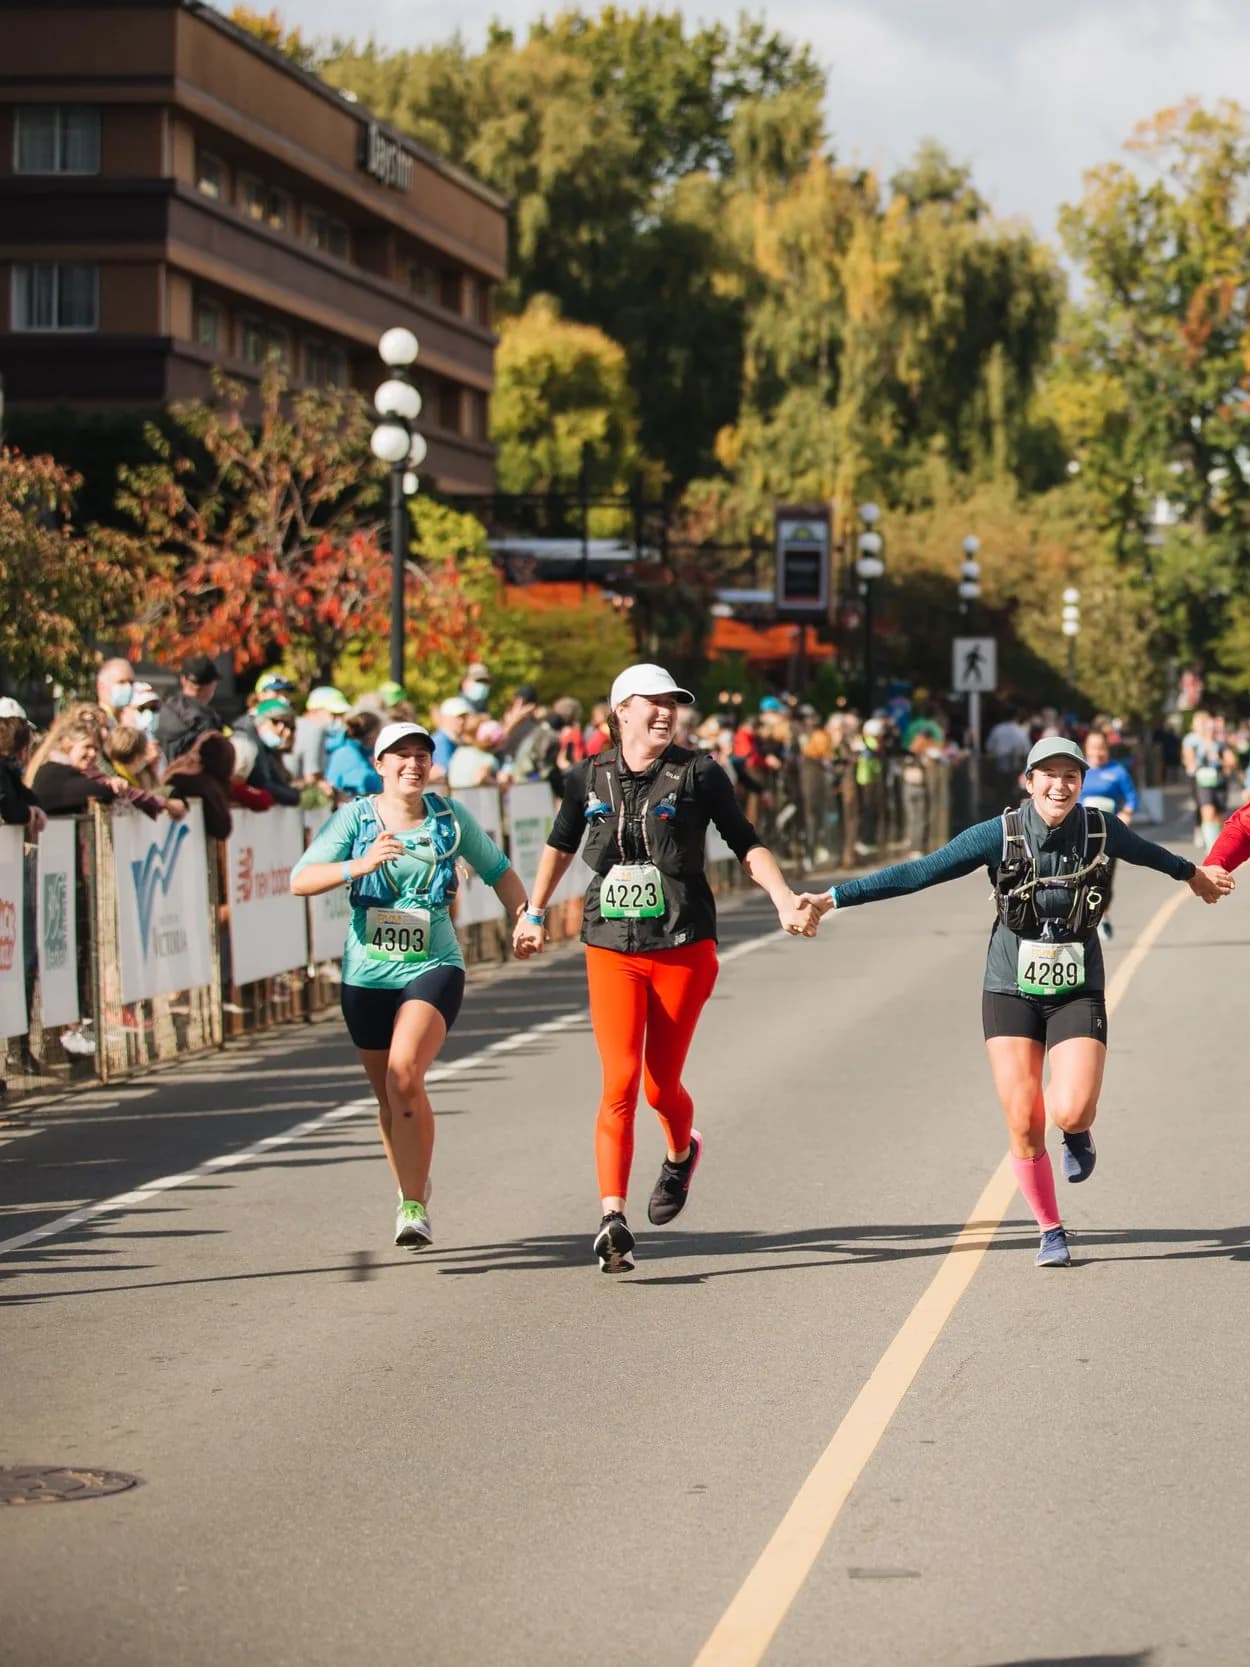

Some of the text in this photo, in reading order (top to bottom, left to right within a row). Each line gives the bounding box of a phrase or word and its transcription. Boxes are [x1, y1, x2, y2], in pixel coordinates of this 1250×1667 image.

[605, 882, 658, 909] 4223
[372, 927, 424, 952] 4303
[1023, 961, 1078, 986] 4289
